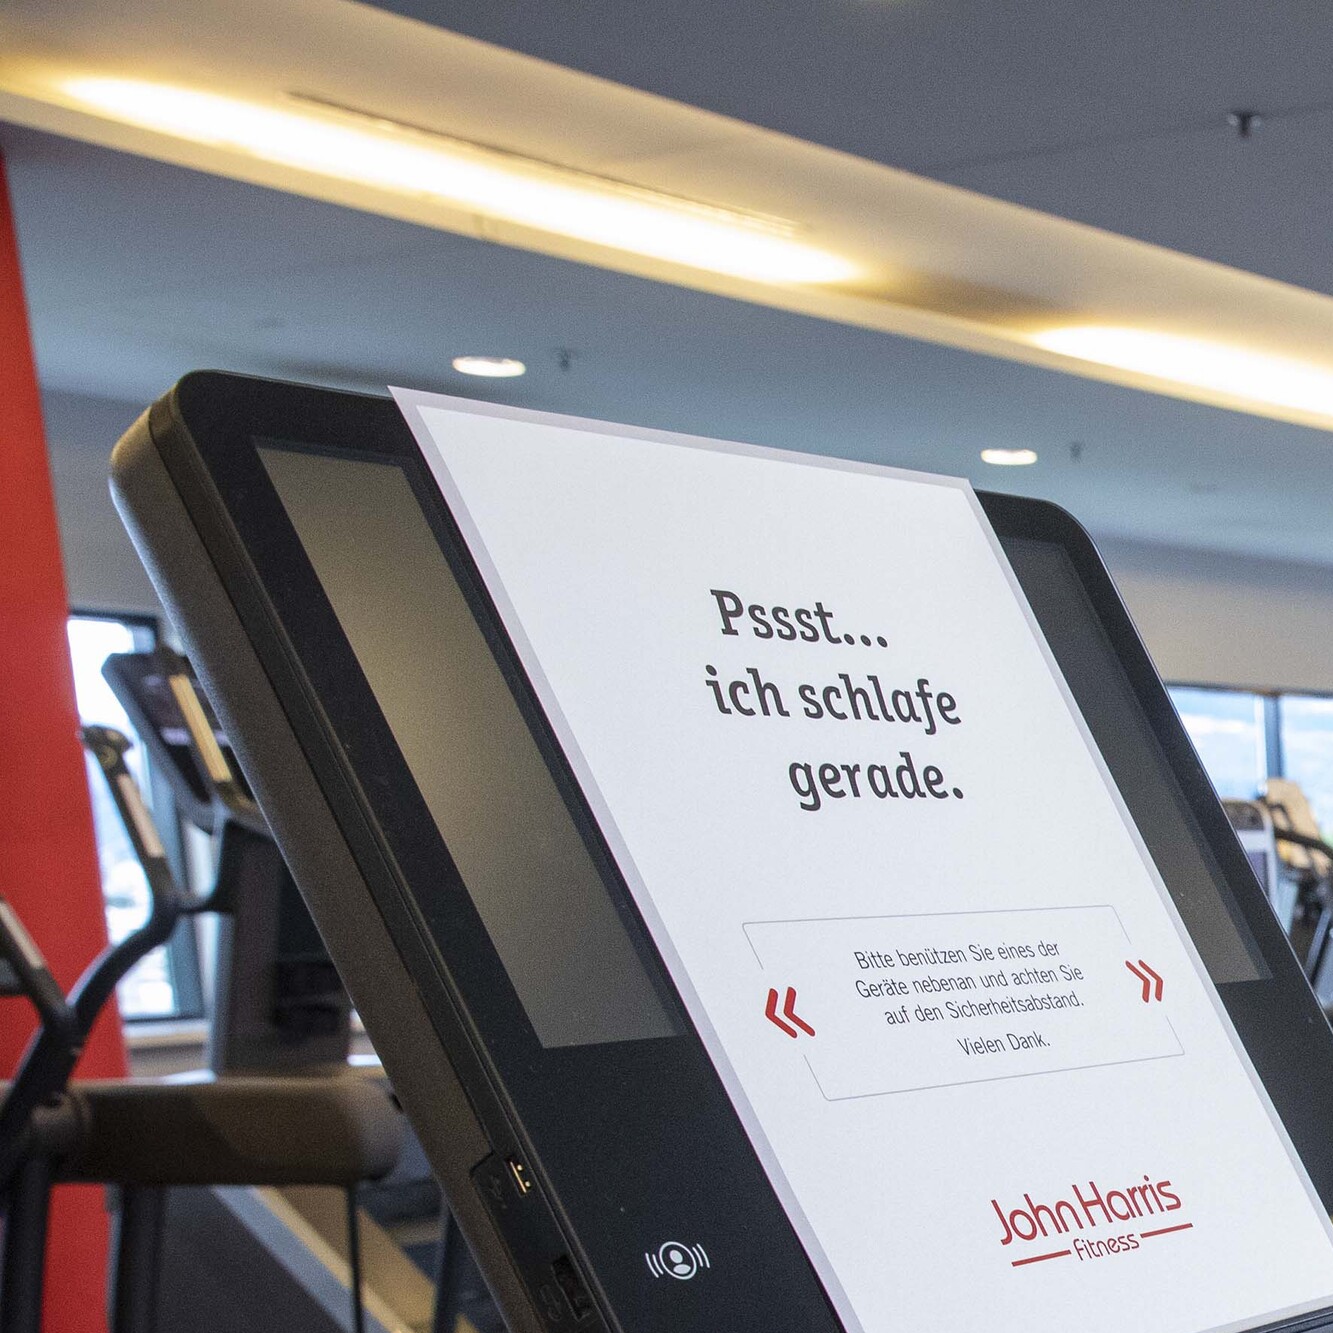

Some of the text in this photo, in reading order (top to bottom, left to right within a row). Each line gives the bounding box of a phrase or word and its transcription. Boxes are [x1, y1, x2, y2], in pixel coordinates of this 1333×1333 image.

[710, 588, 888, 648] Pssst...
[705, 664, 962, 736] ich schlafe
[788, 751, 964, 812] gerade.
[854, 940, 1061, 969] Bitte benützen Sie eines der
[855, 964, 1084, 998] Geräte nebenan und achten Sie
[884, 990, 1084, 1025] auf den Sicherheitsabstand.
[957, 1030, 1051, 1056] Vielen Dank.
